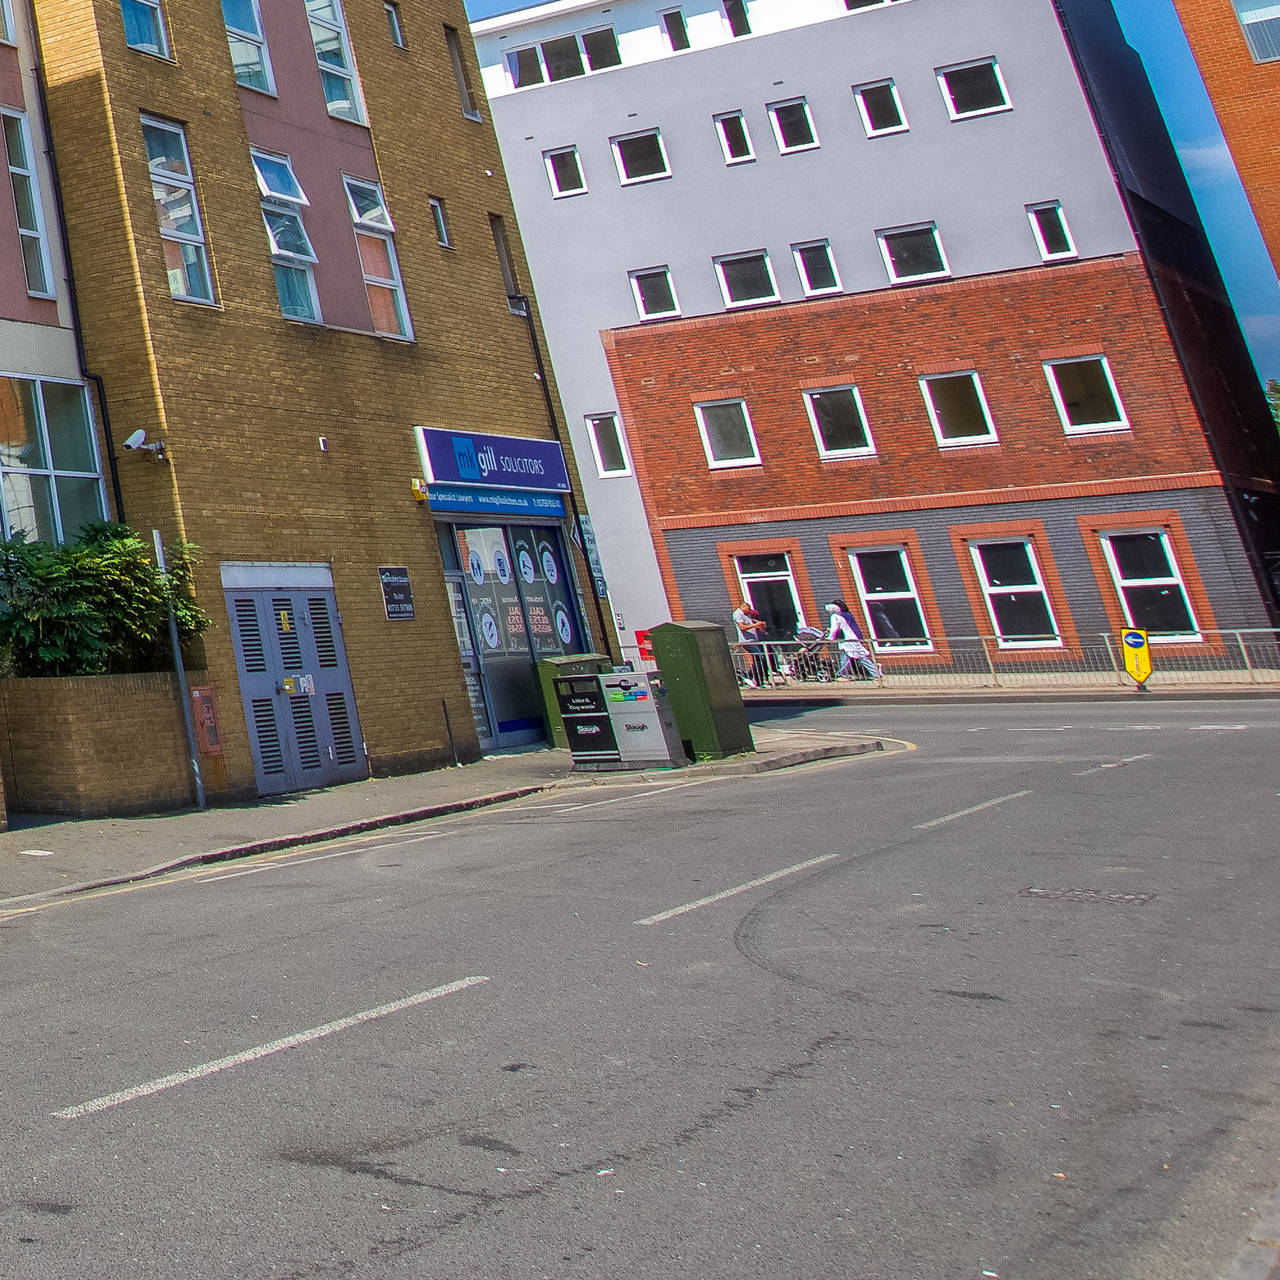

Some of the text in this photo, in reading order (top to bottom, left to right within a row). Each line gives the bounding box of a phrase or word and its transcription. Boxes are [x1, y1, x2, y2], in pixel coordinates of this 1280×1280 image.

[457, 444, 544, 477] mk gill SOLICITORS
[624, 723, 648, 732] Slough
